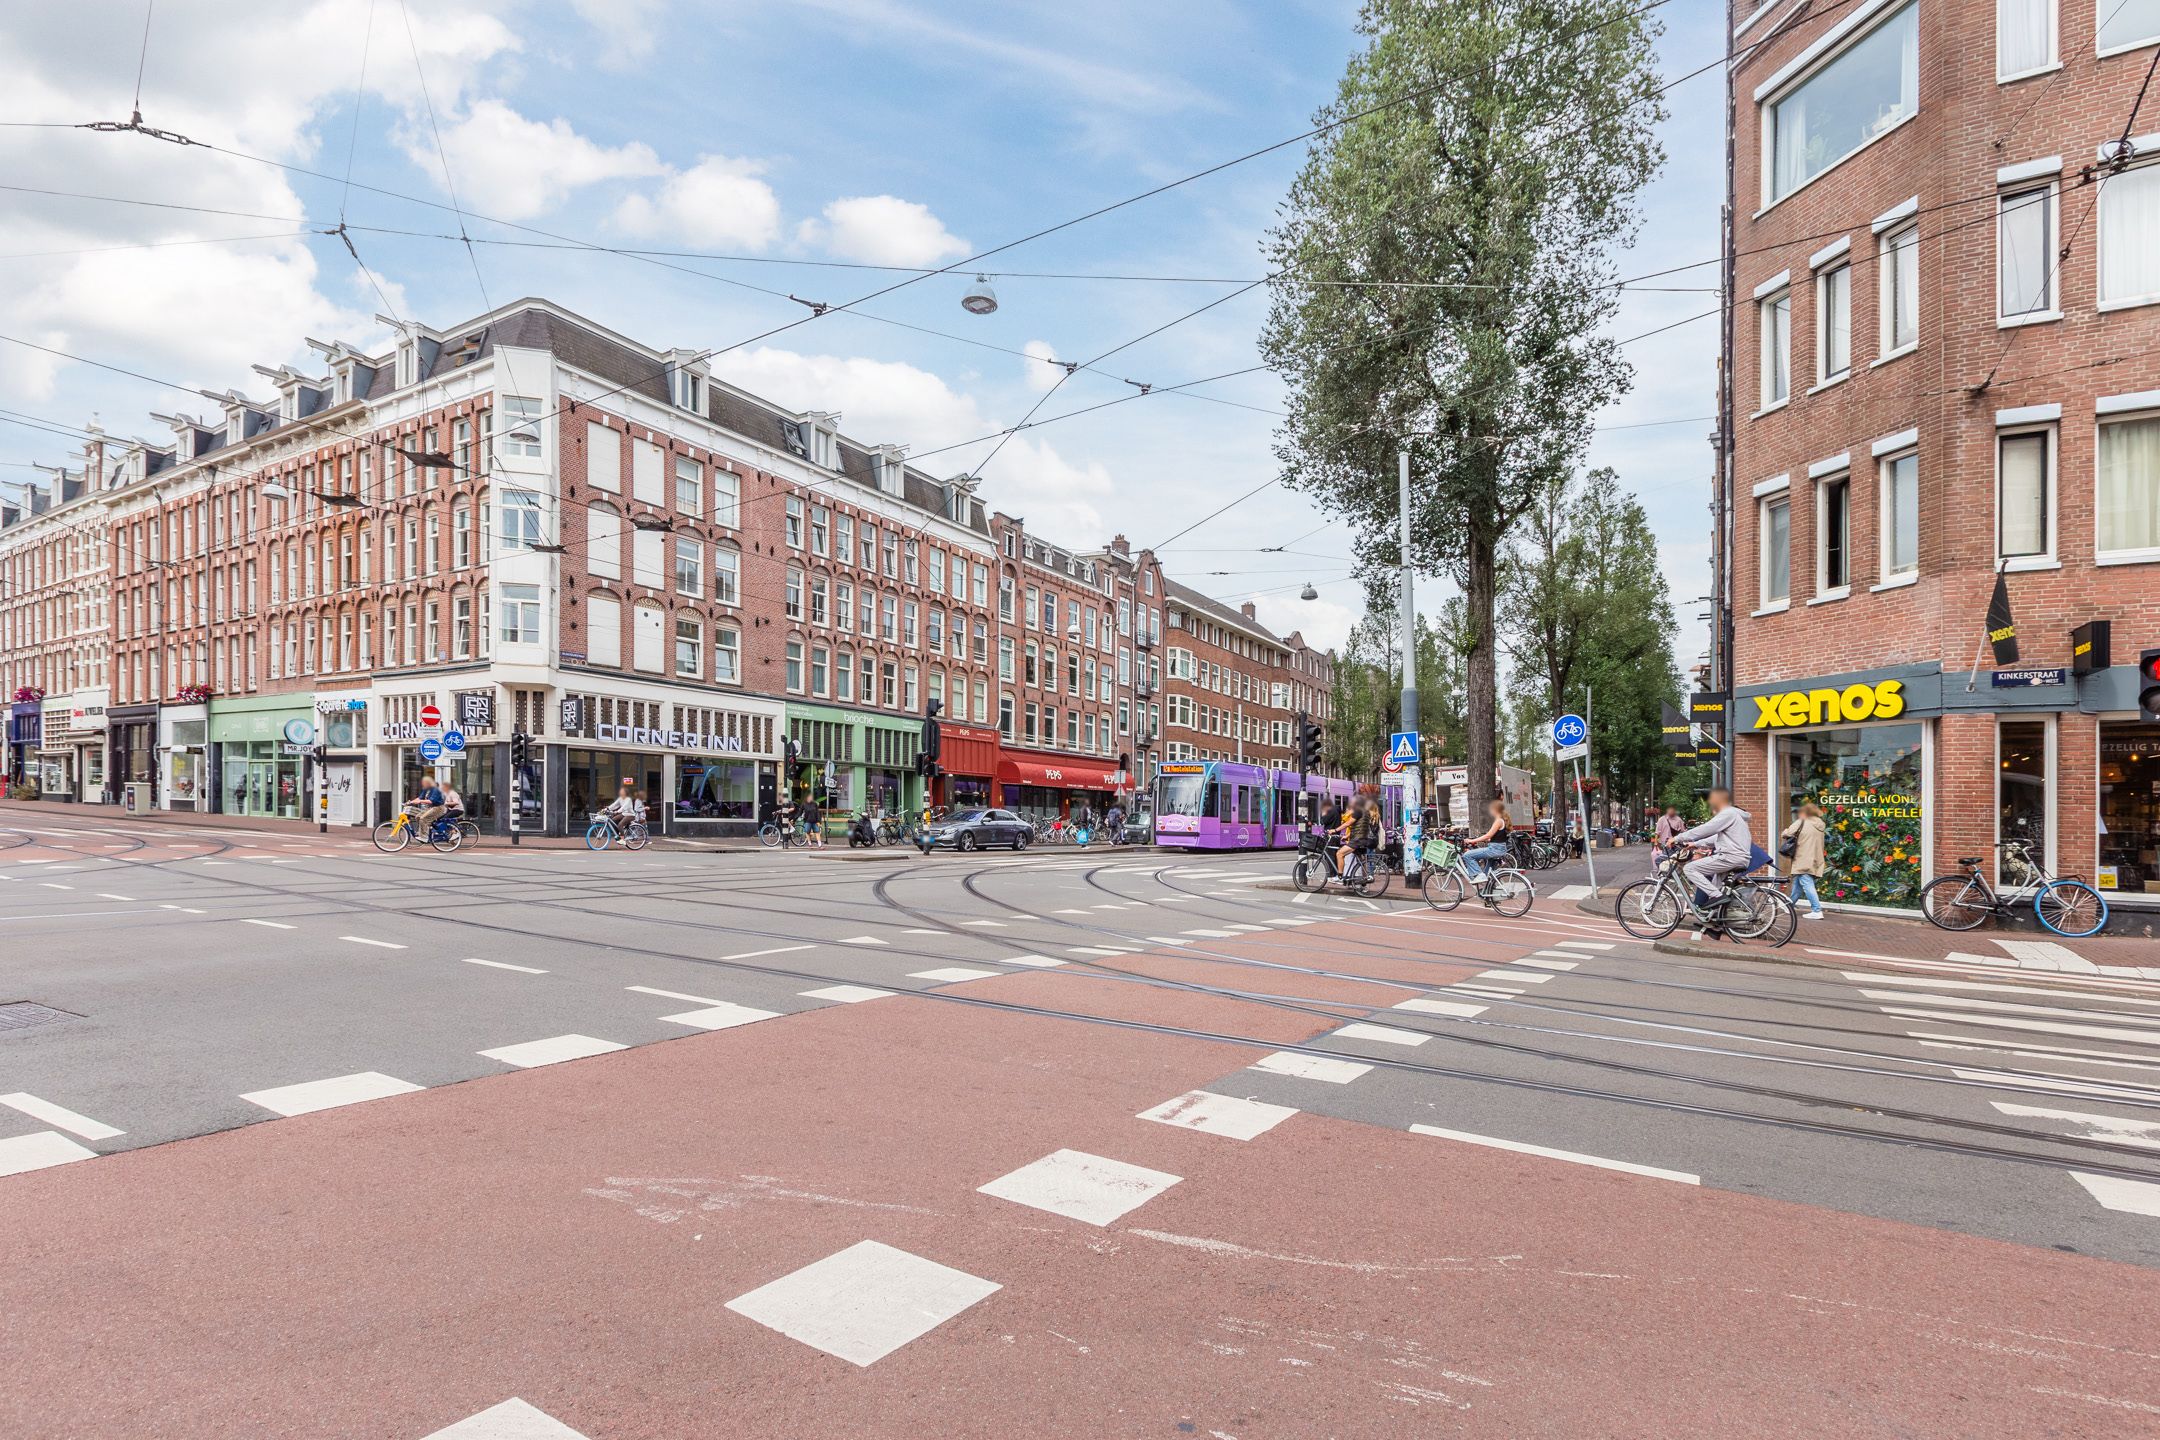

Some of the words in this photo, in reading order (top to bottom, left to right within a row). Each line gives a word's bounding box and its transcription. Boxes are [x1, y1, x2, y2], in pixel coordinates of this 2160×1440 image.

[1989, 626, 2016, 643] xeno
[2075, 641, 2092, 656] xenos
[1998, 671, 2059, 680] KINKERSTRAAT
[1692, 703, 1724, 712] xenos
[1753, 679, 1904, 729] xenos
[1662, 726, 1690, 734] xenos
[597, 723, 698, 748] CORNER
[706, 735, 742, 751] INN
[2100, 743, 2147, 752] EZELLIG
[1045, 769, 1062, 780] PEPS
[1103, 774, 1117, 784] PEP
[1820, 794, 1876, 805] GEZELLIG
[1852, 808, 1868, 817] EN
